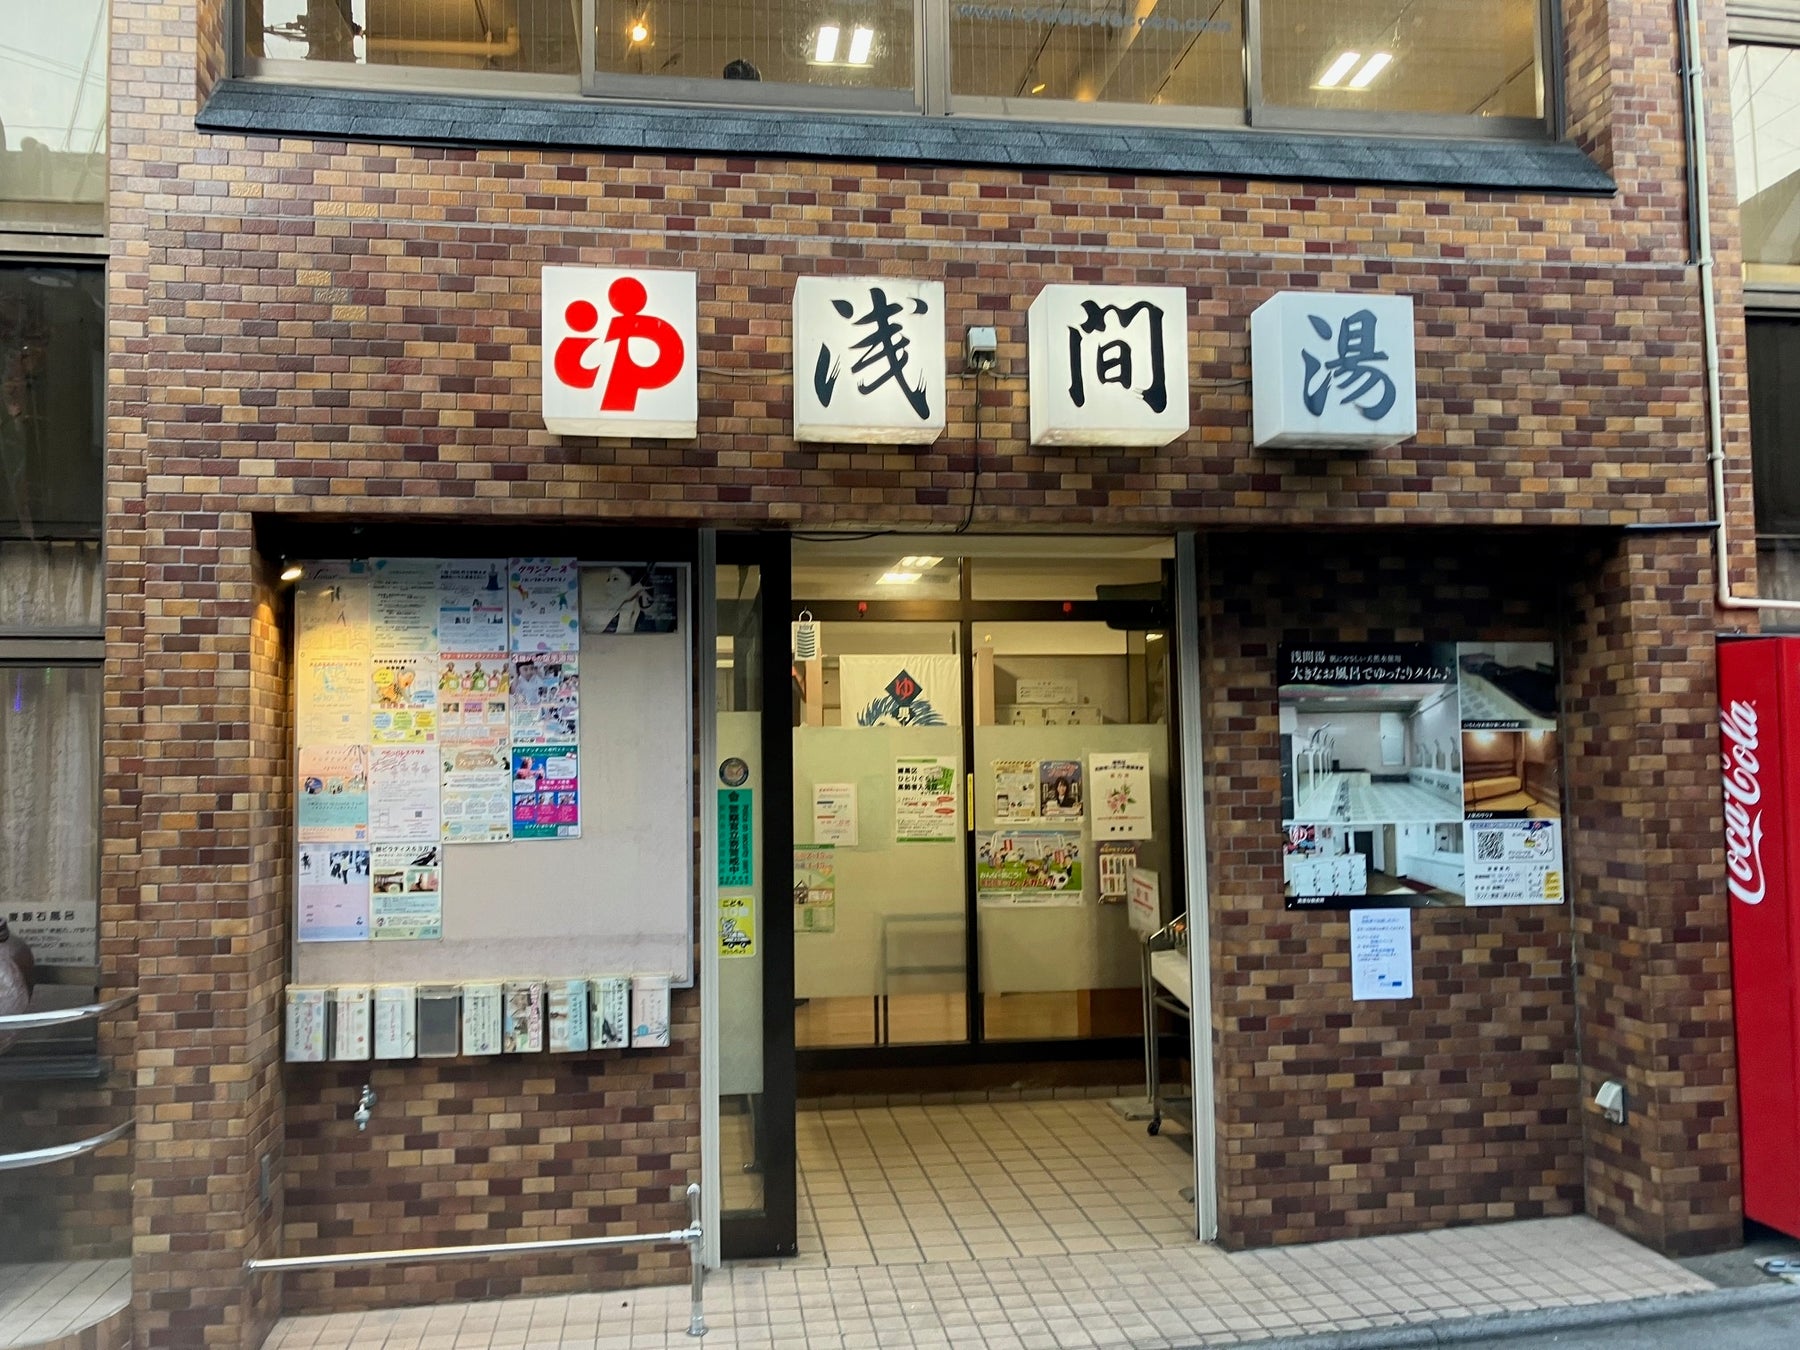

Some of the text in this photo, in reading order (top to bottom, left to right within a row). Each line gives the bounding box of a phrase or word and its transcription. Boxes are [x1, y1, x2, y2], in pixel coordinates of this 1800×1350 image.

[1290, 650, 1327, 663] 浅間湯
[895, 677, 915, 702] ゆ
[1720, 699, 1765, 905] Coca-Cola
[722, 899, 744, 908] こども
